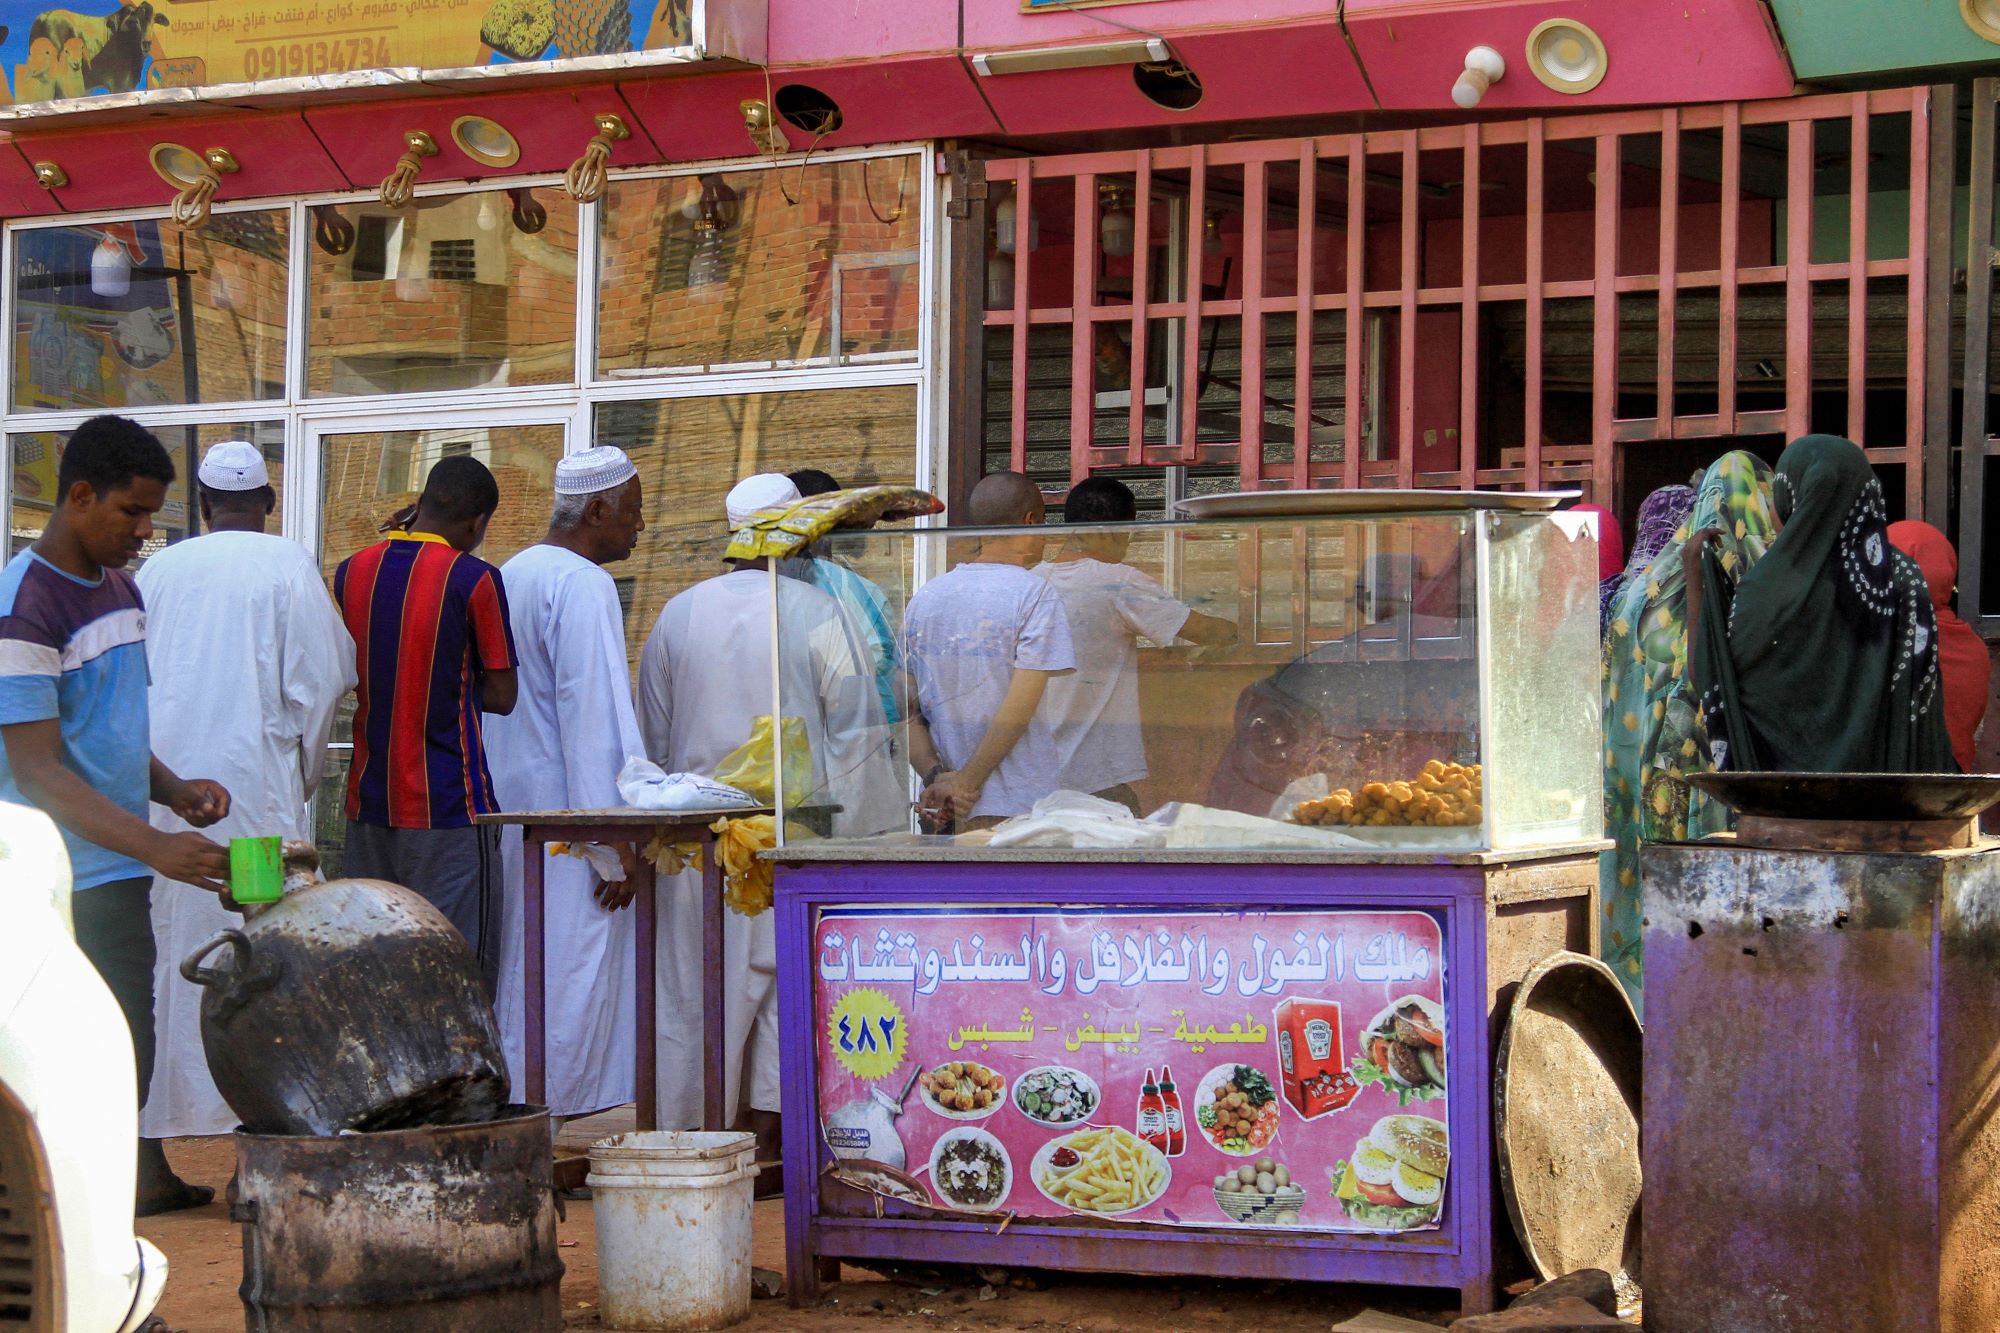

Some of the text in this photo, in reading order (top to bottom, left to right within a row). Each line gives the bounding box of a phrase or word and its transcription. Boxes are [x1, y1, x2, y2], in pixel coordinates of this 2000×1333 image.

[212, 15, 235, 32] بيض
[244, 36, 392, 81] 0919134734
[820, 928, 1067, 996] والسندوتشات
[1237, 929, 1345, 997] الفول
[1354, 930, 1431, 982] ملك
[837, 1014, 897, 1055] ٤٨٢
[948, 1007, 1035, 1051] شبس
[1065, 1012, 1141, 1055] بيض
[1170, 1009, 1268, 1055] طعمية
